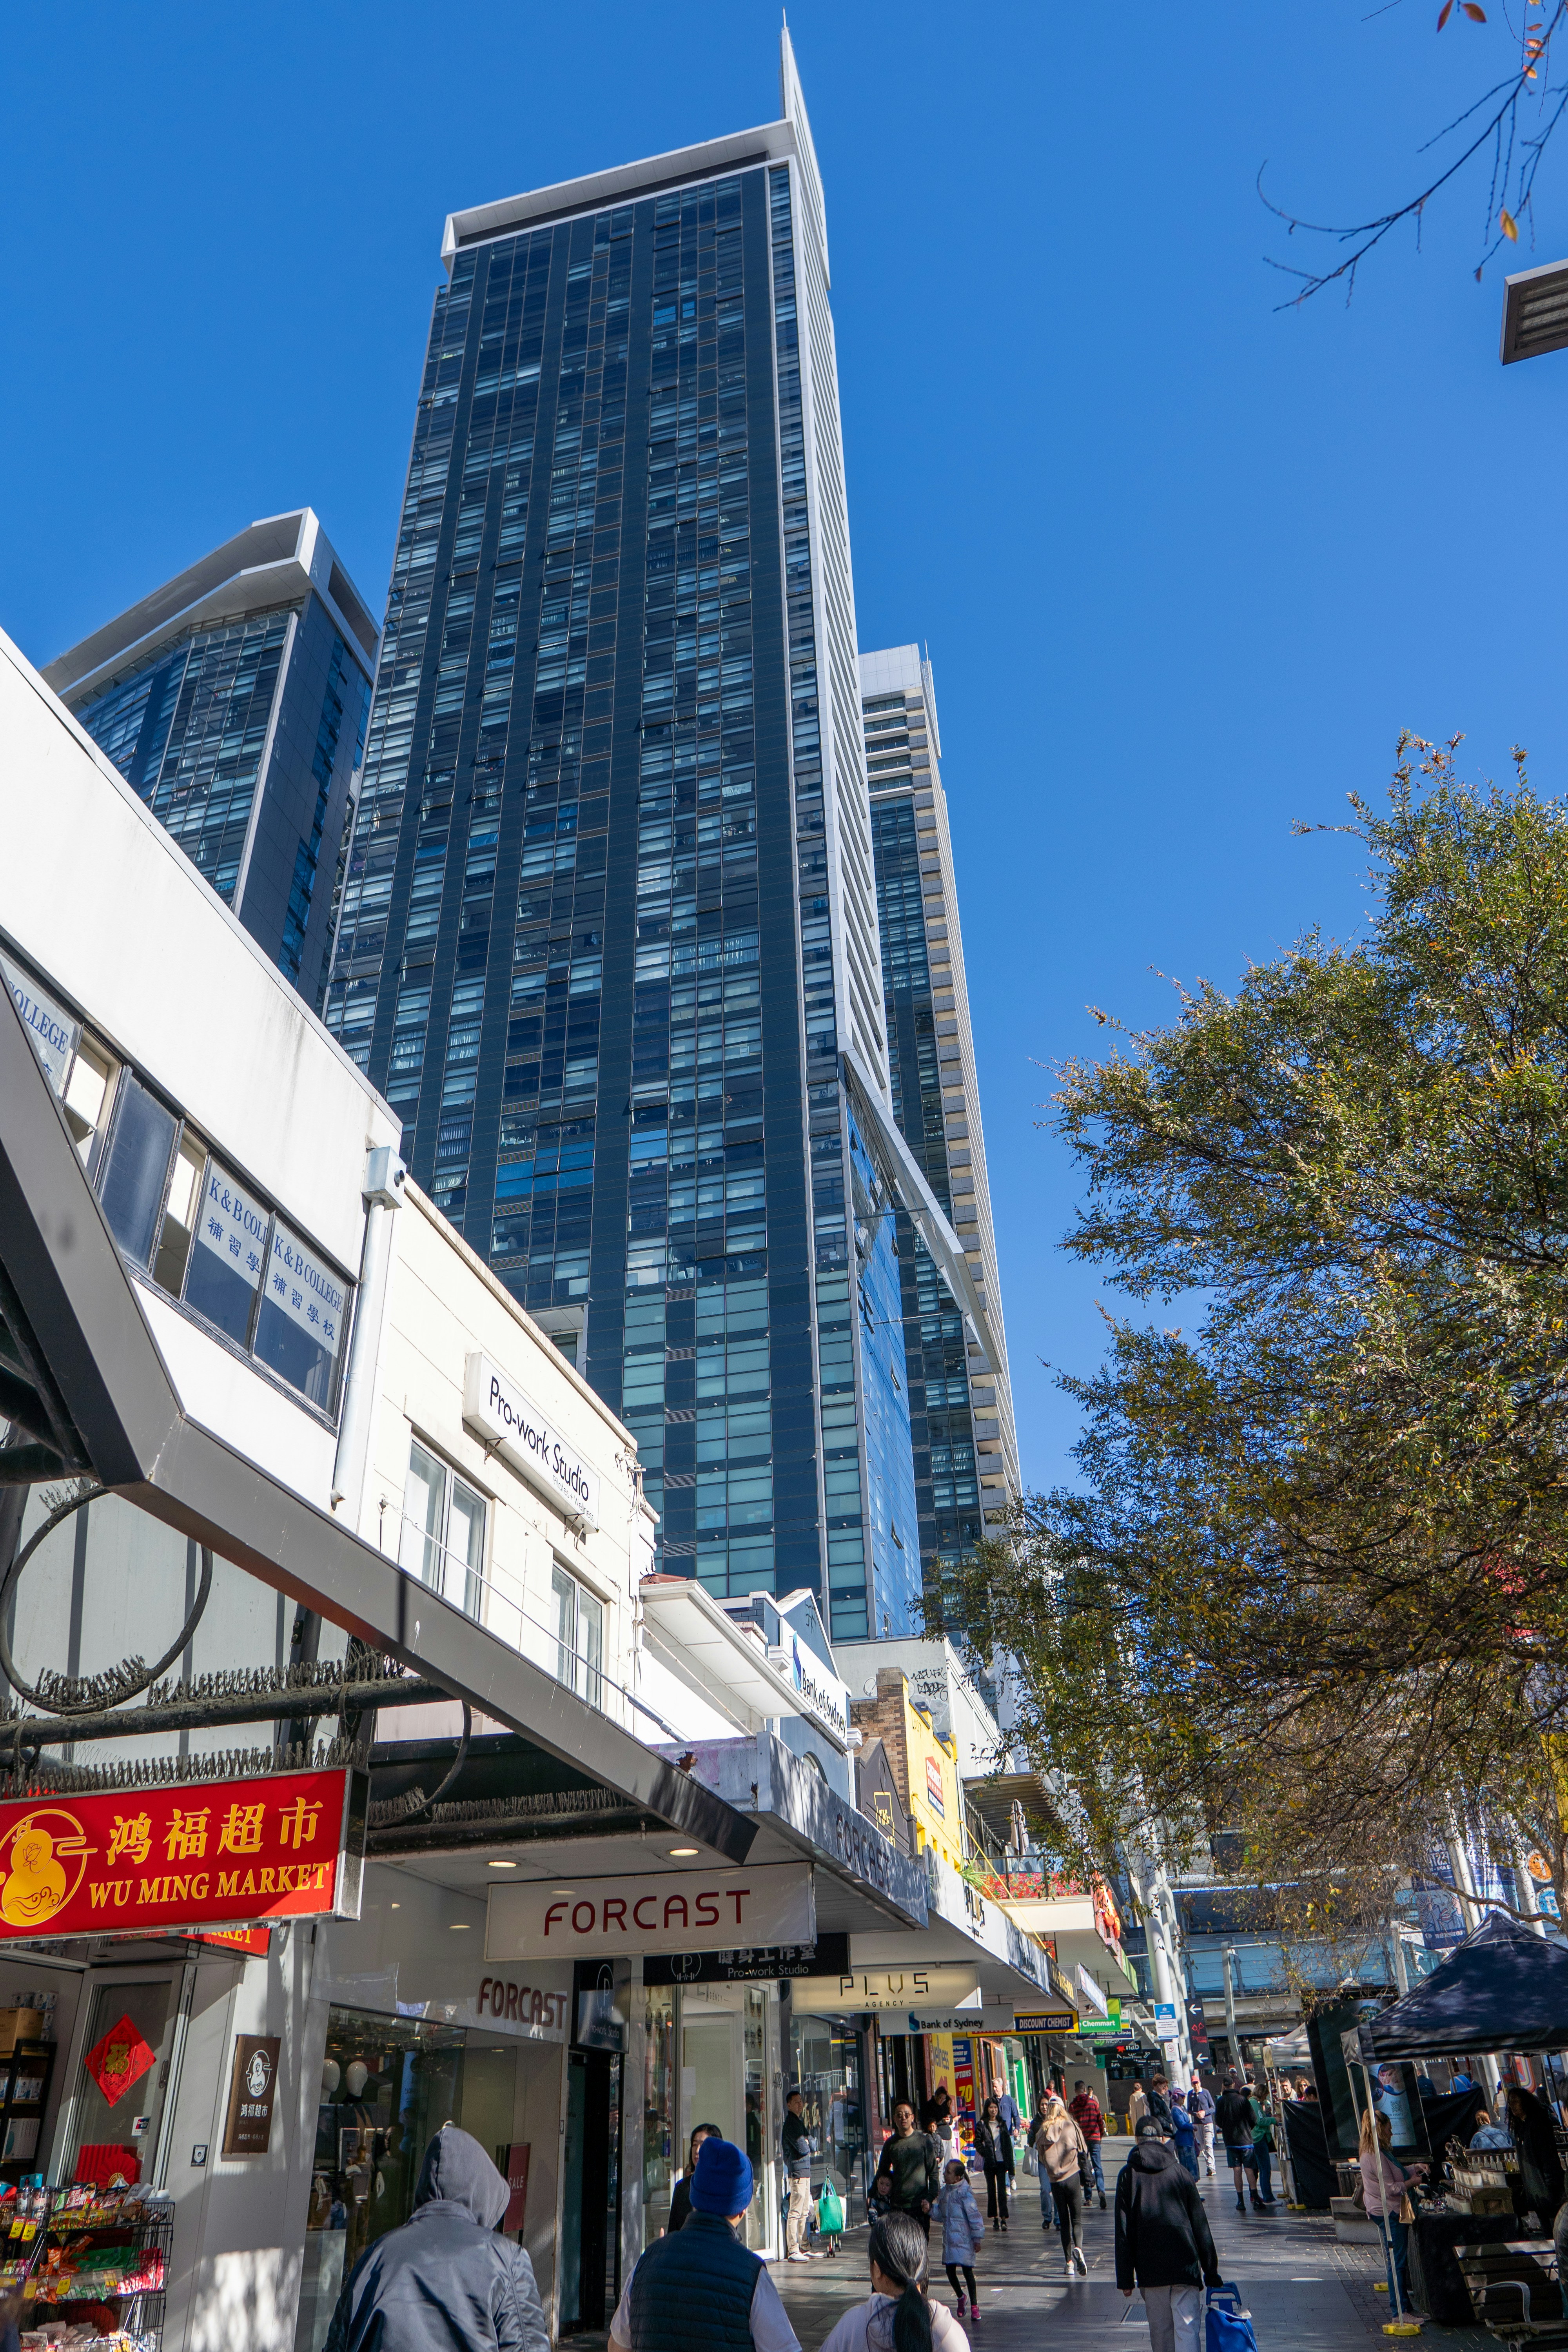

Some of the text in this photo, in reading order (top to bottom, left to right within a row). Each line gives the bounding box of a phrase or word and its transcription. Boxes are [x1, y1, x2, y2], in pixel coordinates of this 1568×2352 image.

[209, 1176, 221, 1202] K
[221, 1189, 230, 1212] &
[232, 1198, 242, 1221] B
[273, 1234, 343, 1314] K & B COLLEGE
[273, 1273, 334, 1341] 補習學校
[490, 1376, 588, 1501] Pro-work Studio
[553, 1475, 569, 1499] Pilates
[574, 1497, 594, 1523] Wellness
[802, 1668, 846, 1739] Bank of Sydney
[107, 1797, 323, 1866] 鸿福超市
[836, 1813, 889, 1893] FORCAST
[89, 1862, 330, 1908] WU MING MARKET
[544, 1889, 750, 1936] FORCAST
[728, 1964, 809, 1978] Pro-work Studio
[840, 1972, 929, 1998] PLUS
[477, 1977, 567, 2029] FORCAST
[921, 2018, 983, 2030] Bank of Sydney
[1019, 2016, 1071, 2029] DISCOUNT CHEMIST
[240, 2103, 269, 2118] 鸿福超市
[508, 2176, 524, 2190] SALE
